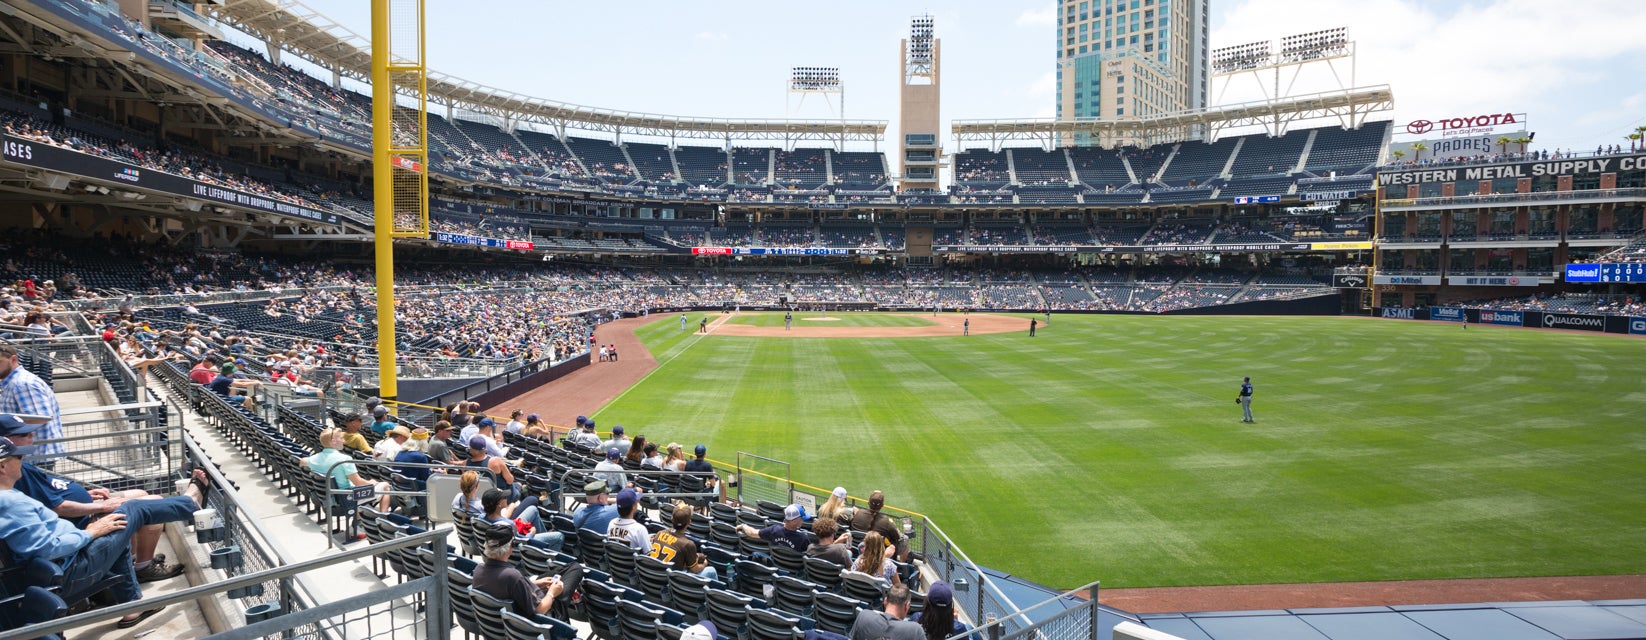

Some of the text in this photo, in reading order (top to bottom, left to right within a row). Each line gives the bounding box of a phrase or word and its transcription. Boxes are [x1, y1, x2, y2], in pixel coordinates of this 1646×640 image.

[1439, 113, 1516, 130] TOYOTA
[4, 140, 32, 160] ASES
[1433, 138, 1490, 156] PADRES
[1378, 156, 1646, 186] WESTERN METAL SUPPLY CO
[193, 184, 207, 196] LIVE
[208, 187, 236, 202] LIFEPROOF
[238, 194, 250, 205] WITH
[1306, 191, 1349, 200] CUTWATER
[1568, 268, 1598, 278] StubHub!
[1340, 276, 1364, 284] Callaway
[1383, 308, 1413, 319] ASML
[1438, 308, 1459, 316] ViaSat
[1544, 314, 1602, 327] QUALCOMM
[356, 489, 372, 498] 127
[610, 528, 628, 539] KEMP
[657, 532, 678, 545] KEMP
[774, 537, 795, 549] OAKLAND
[650, 543, 677, 563] 27
